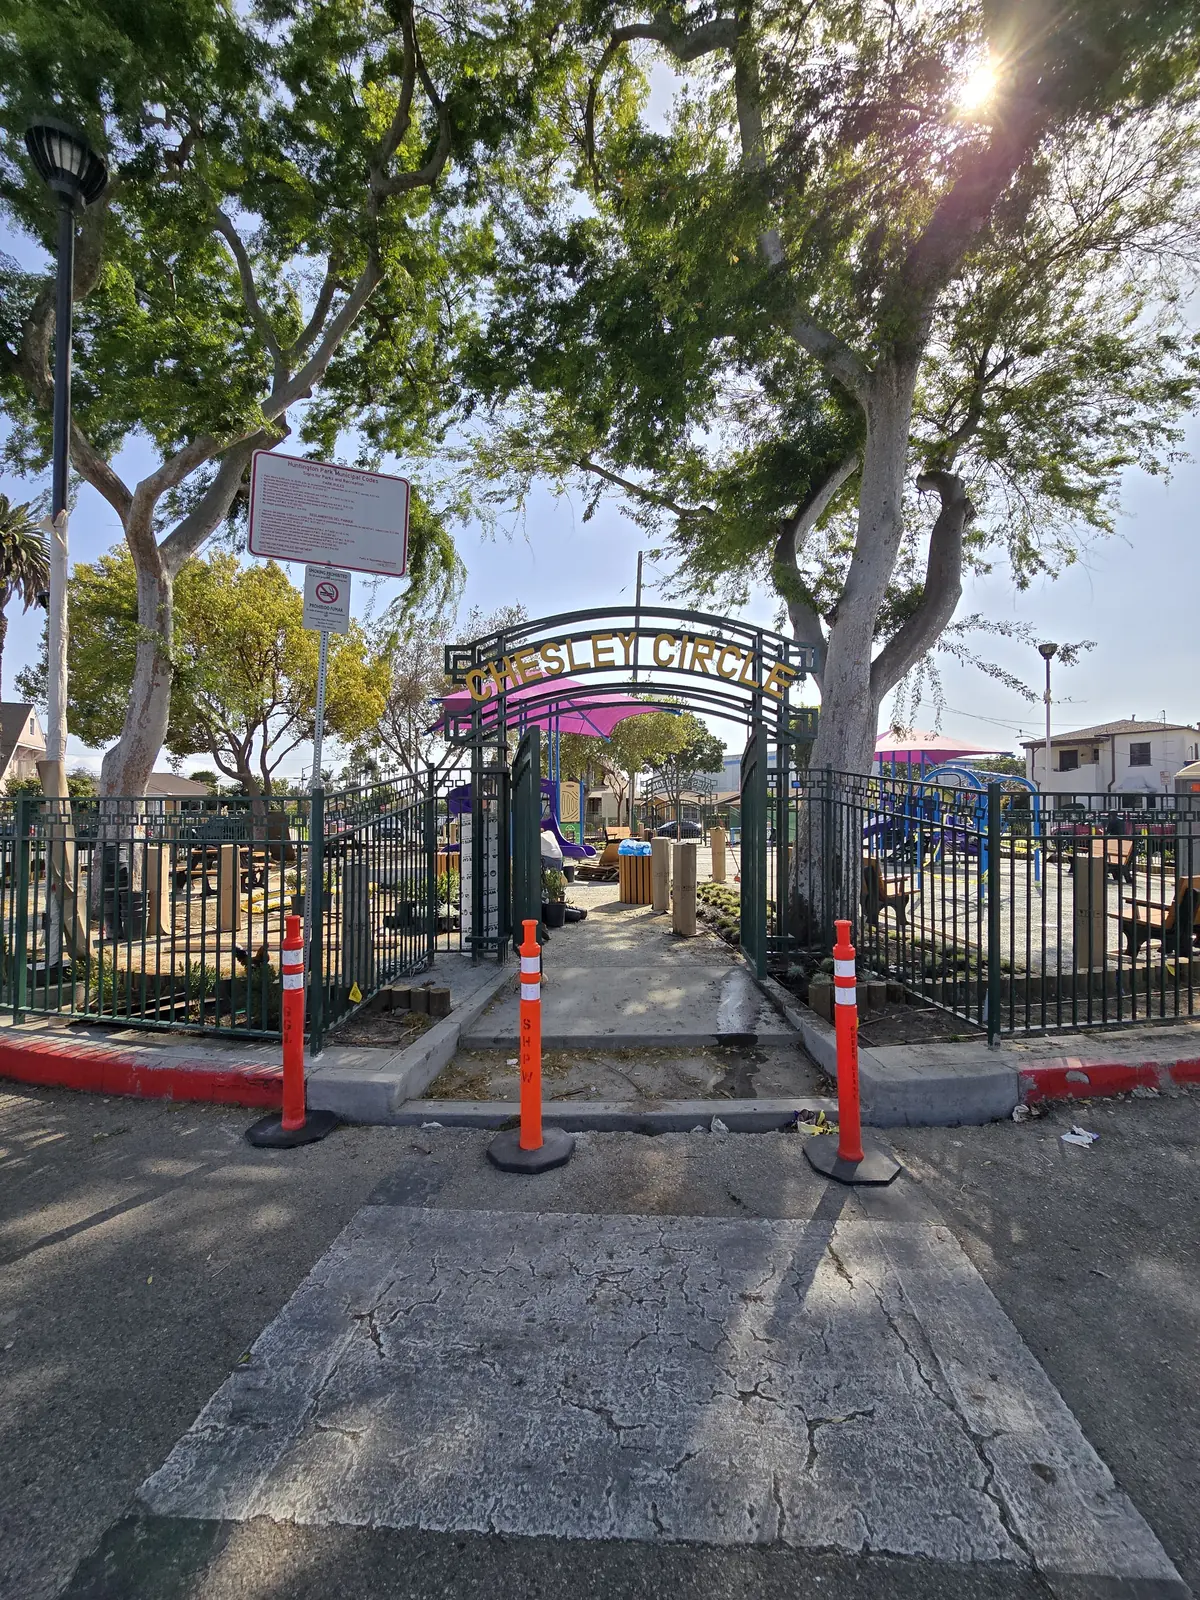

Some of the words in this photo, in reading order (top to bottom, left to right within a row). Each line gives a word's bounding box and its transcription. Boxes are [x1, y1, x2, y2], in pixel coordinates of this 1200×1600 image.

[288, 461, 319, 473] Huntington
[335, 470, 361, 480] Municipal
[362, 476, 378, 484] Codes
[308, 568, 325, 576] SMOKING
[326, 571, 348, 579] PROHIBITED
[465, 632, 637, 701] CHESLEY
[653, 633, 796, 698] CIRCLE
